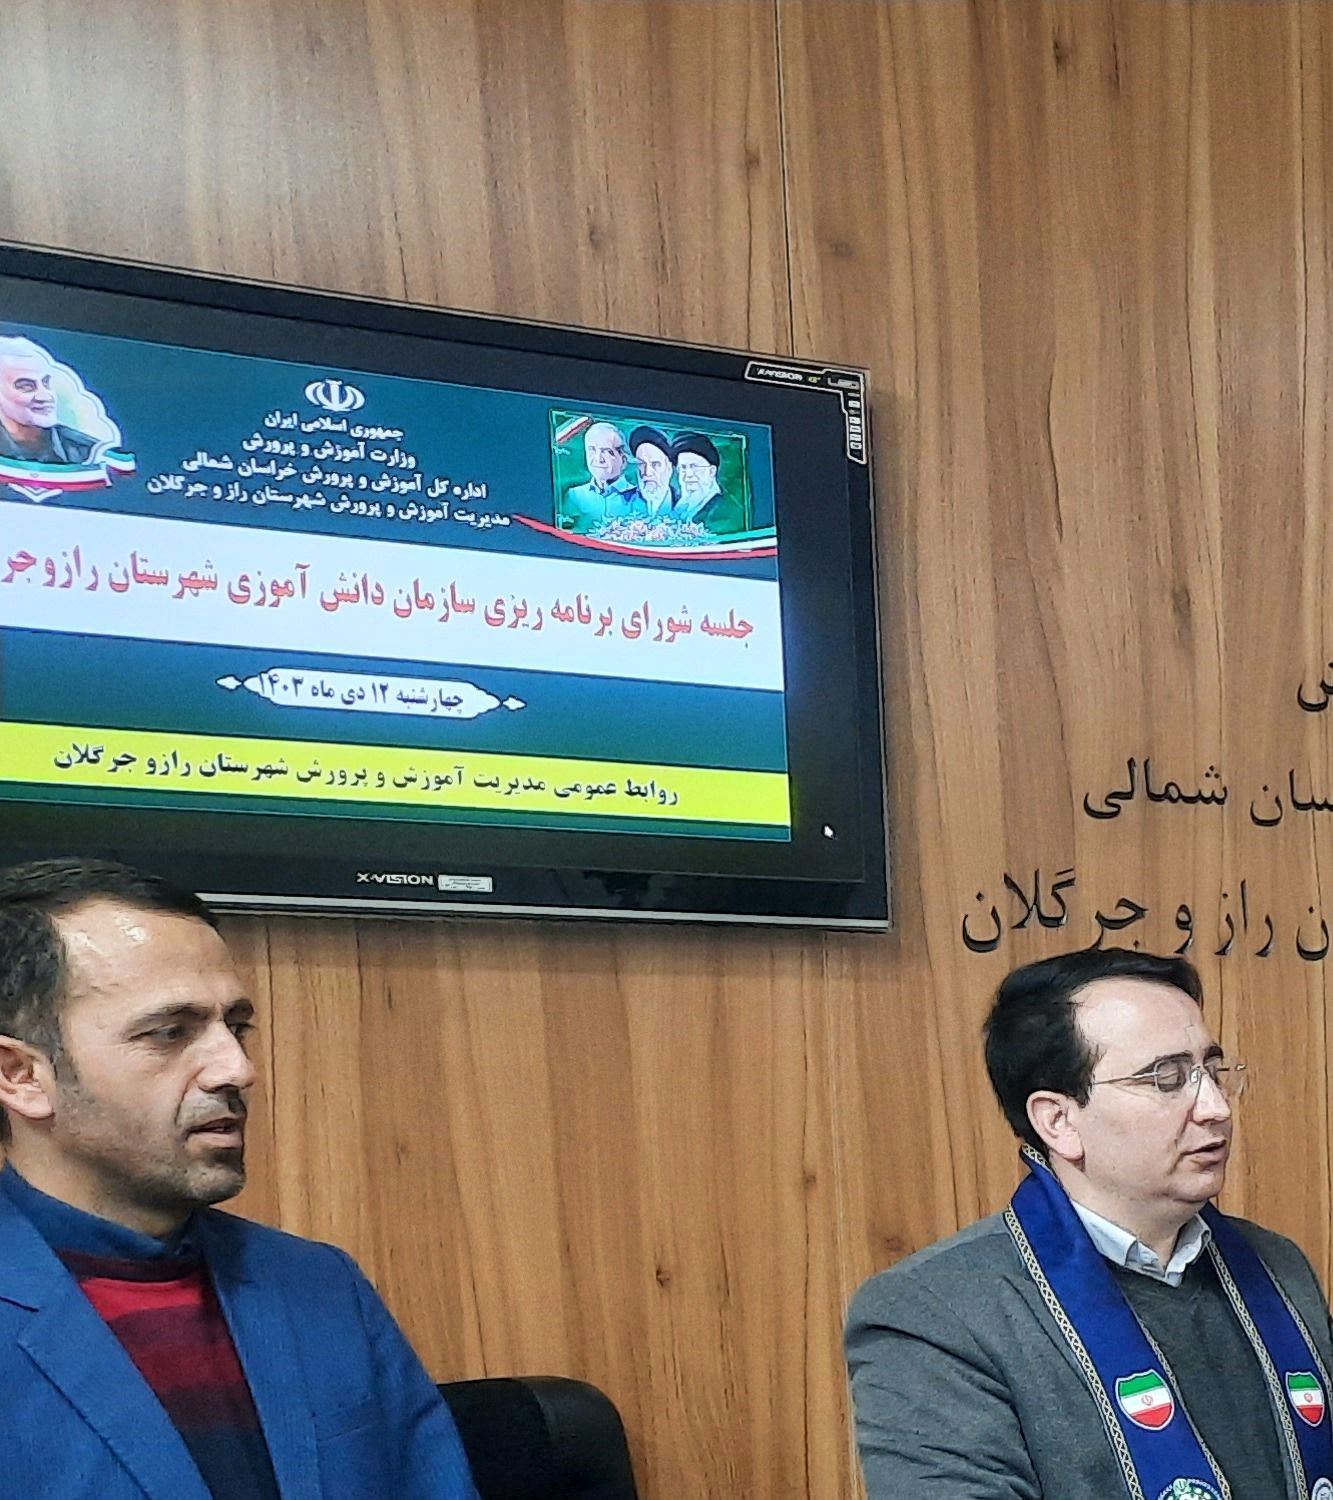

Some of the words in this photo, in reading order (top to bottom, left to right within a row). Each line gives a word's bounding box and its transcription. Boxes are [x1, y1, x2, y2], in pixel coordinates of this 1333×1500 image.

[264, 409, 298, 430] ایران
[300, 414, 347, 434] اسلامی
[350, 421, 404, 441] جمهوری
[242, 431, 296, 457] پرورش
[300, 443, 311, 459] و
[313, 440, 366, 463] آموزش
[370, 444, 417, 470] وزارت
[182, 450, 234, 473] شمالی
[237, 456, 298, 482] خراسان
[145, 472, 208, 499] جرگلان
[301, 464, 354, 490] پرورش
[357, 474, 368, 491] و
[371, 471, 422, 496] آموزش
[427, 477, 449, 500] کل
[212, 485, 223, 501] و
[225, 479, 248, 504] راز
[252, 484, 327, 511] شهرستان
[452, 482, 487, 502] اداره
[330, 492, 383, 519] پرورش
[385, 503, 396, 520] و
[399, 500, 450, 522] آموزش
[453, 506, 512, 531] مدیریت
[107, 549, 219, 600] شهرستان
[227, 561, 311, 608] آموزی
[320, 570, 385, 613] دانش
[393, 576, 476, 624] سازمان
[484, 591, 544, 632] ریزی
[550, 591, 613, 638] برنامه
[621, 599, 692, 645] شورای
[699, 606, 755, 650] جلسه
[258, 673, 305, 698] ۱۴۰۳
[311, 679, 336, 700] ماه
[340, 680, 367, 707] دی
[371, 682, 389, 703] ۱۲
[394, 684, 465, 716] چهارشنبه
[198, 751, 289, 782] شهرستان
[295, 757, 368, 789] پرورش
[392, 764, 465, 792] آموزش
[376, 772, 386, 788] و
[472, 770, 547, 796] مدیریت
[552, 778, 618, 801] عمومی
[622, 777, 679, 806] روابط
[1082, 755, 1230, 821] شمالی
[356, 871, 435, 887] X-VISION
[960, 864, 1151, 954] جرگلان
[1214, 876, 1275, 959] راز
[1172, 900, 1196, 956] و
